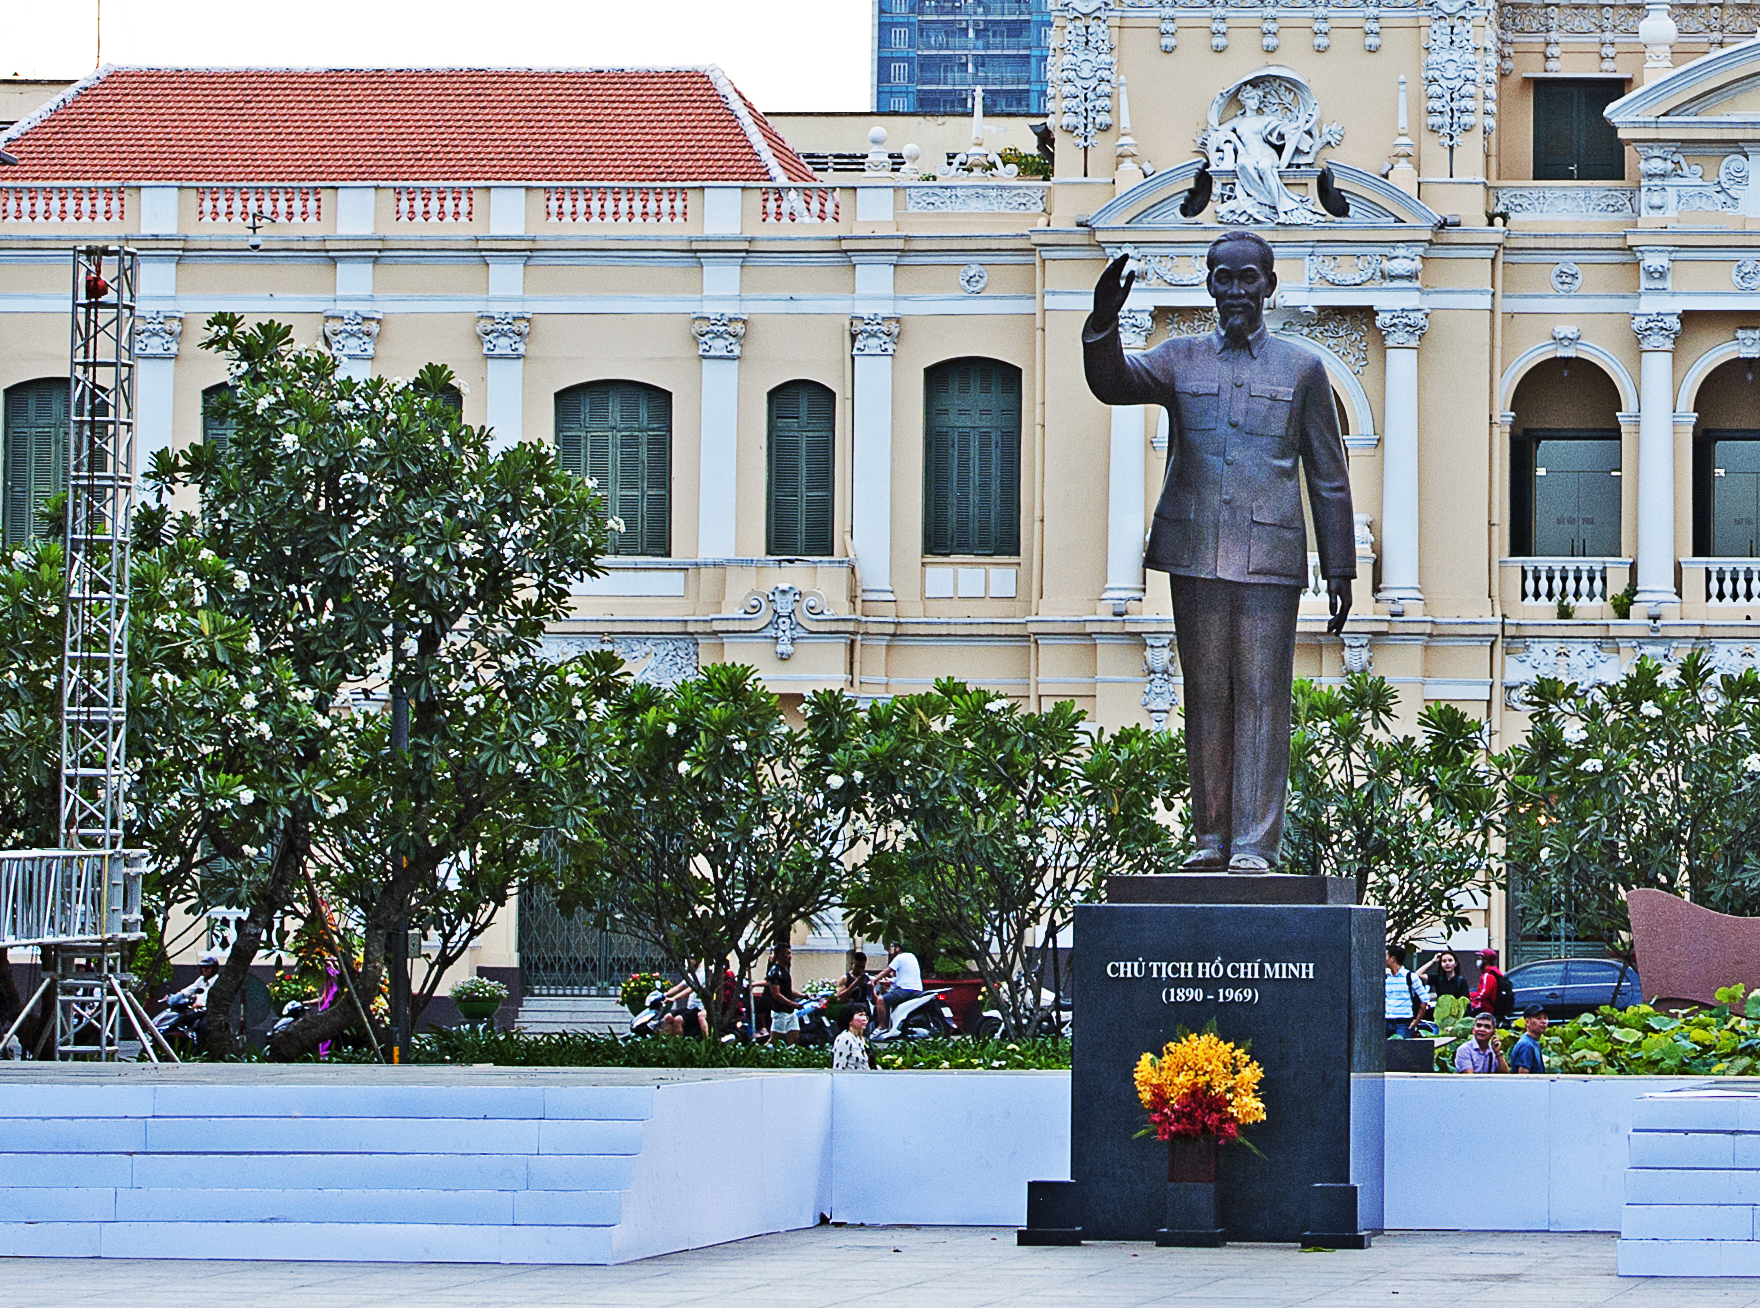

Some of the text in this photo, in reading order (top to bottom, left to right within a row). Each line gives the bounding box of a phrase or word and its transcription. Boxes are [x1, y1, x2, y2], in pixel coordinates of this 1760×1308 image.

[1106, 956, 1315, 981] CHỦ TỊCH HỒ CHÍ MINH
[1162, 988, 1204, 1004] (1890
[1217, 988, 1259, 1004] 1969)
